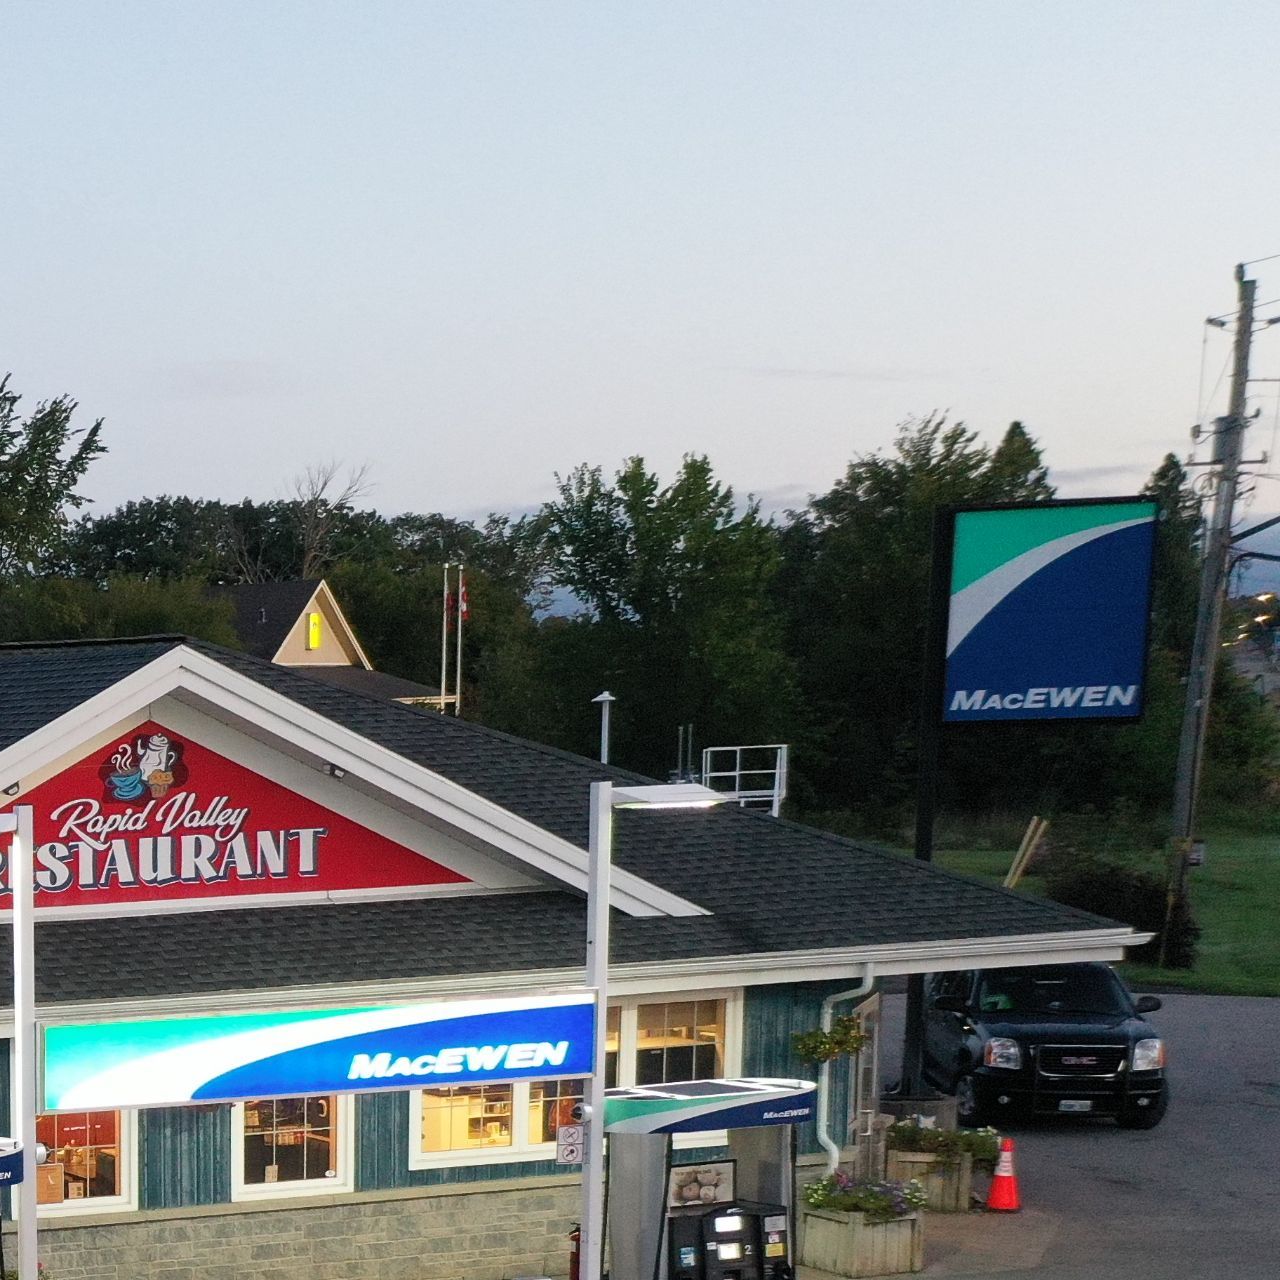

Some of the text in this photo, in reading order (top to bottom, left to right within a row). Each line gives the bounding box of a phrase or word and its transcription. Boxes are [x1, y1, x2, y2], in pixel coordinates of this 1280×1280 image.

[51, 792, 247, 850] Rapid Valley
[744, 1244, 753, 1255] 2
